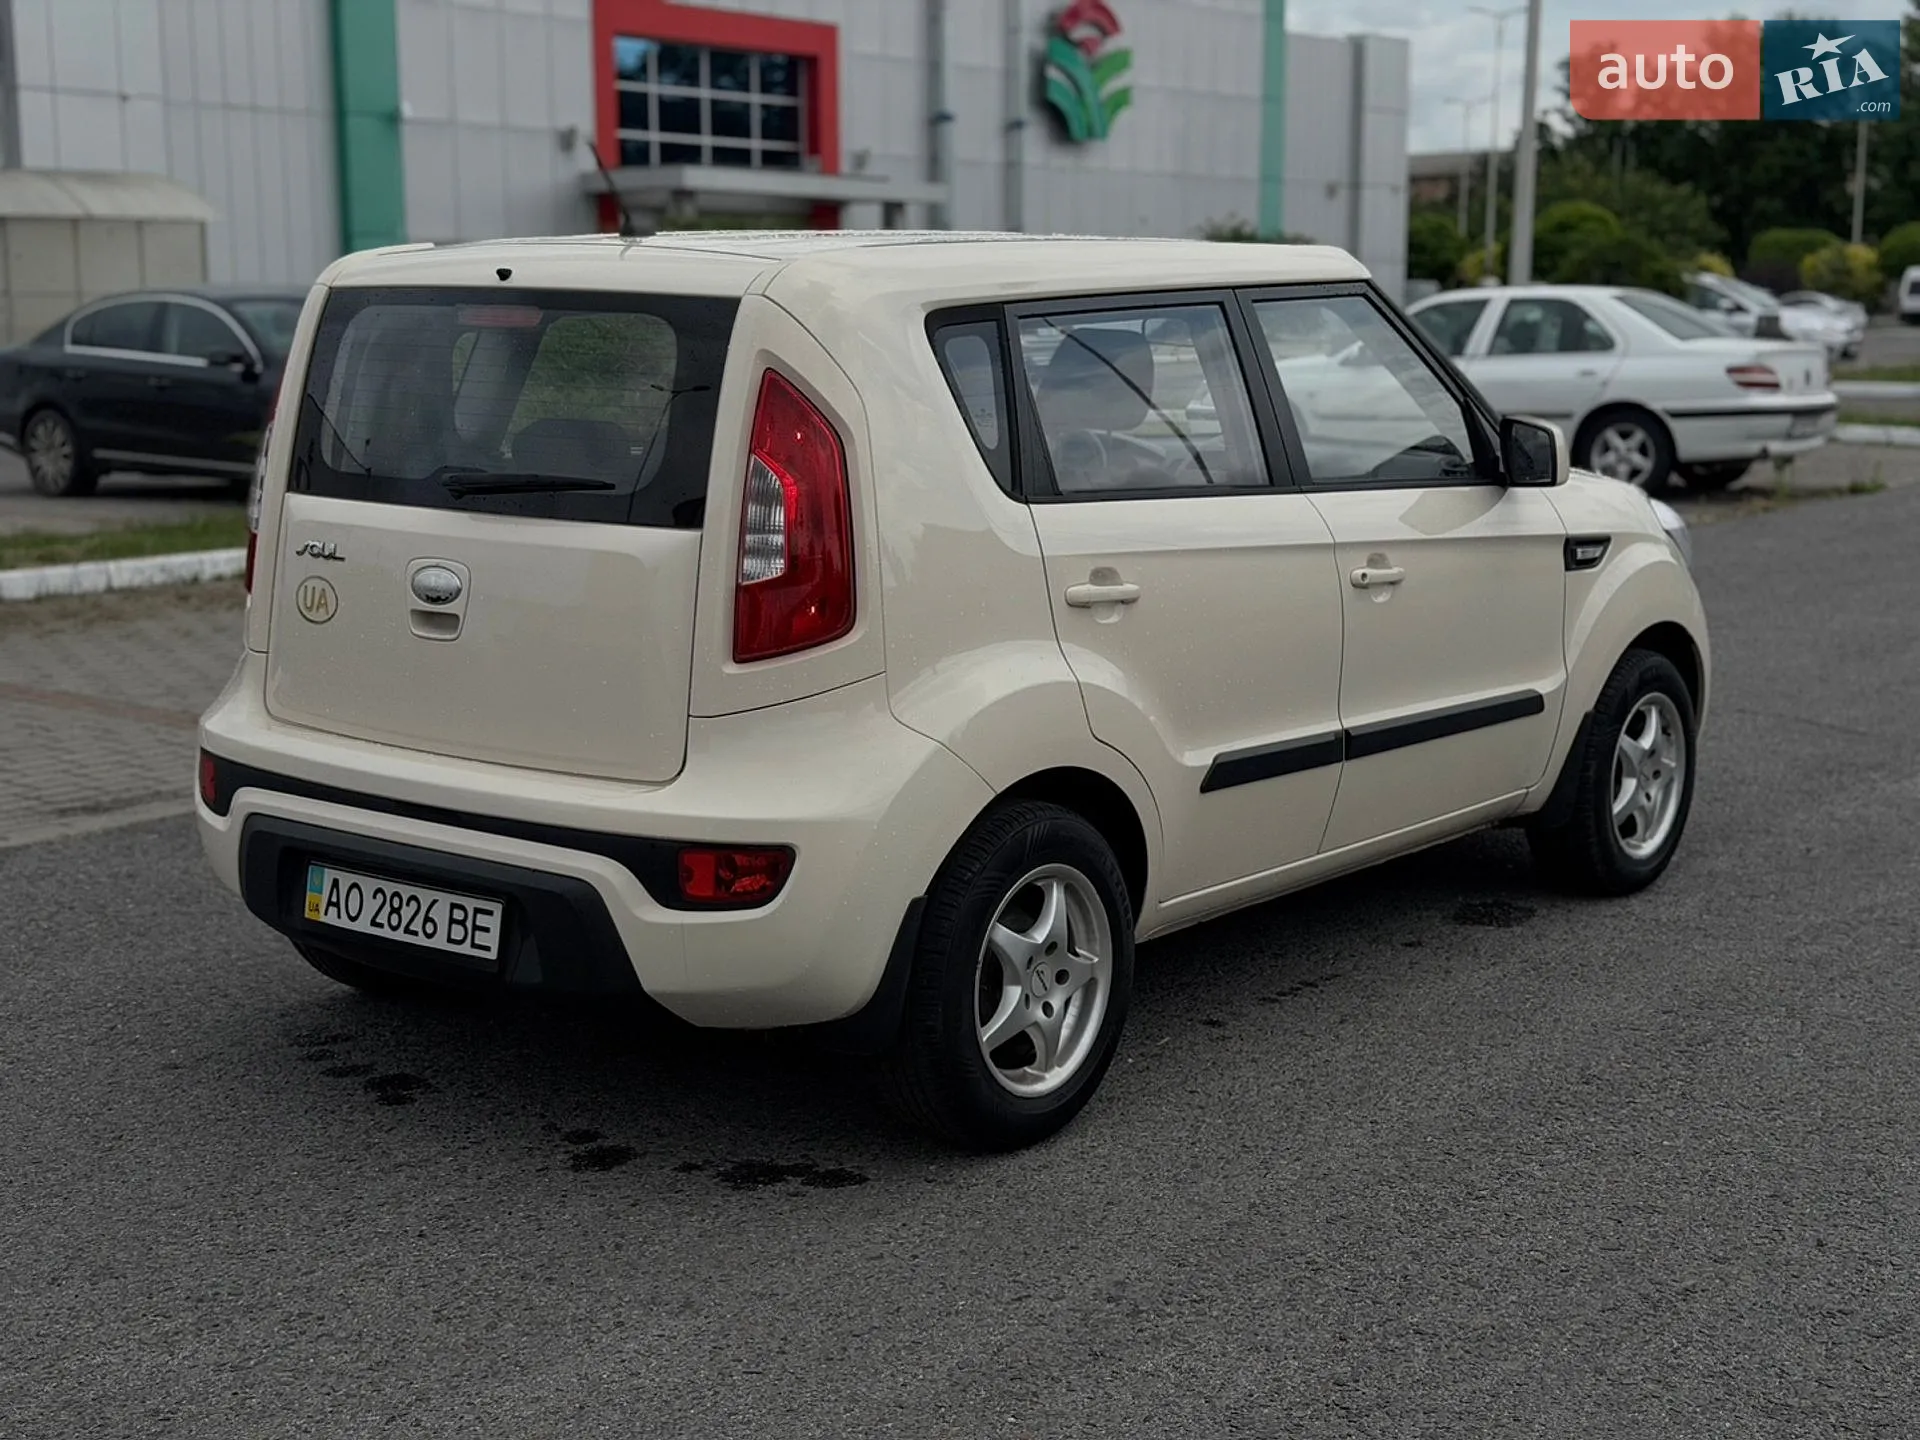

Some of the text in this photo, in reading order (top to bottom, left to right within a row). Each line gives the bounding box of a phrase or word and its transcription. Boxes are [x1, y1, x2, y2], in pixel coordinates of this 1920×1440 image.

[304, 585, 329, 615] UA
[308, 901, 320, 914] UA
[324, 878, 494, 952] AO 2826 BE
